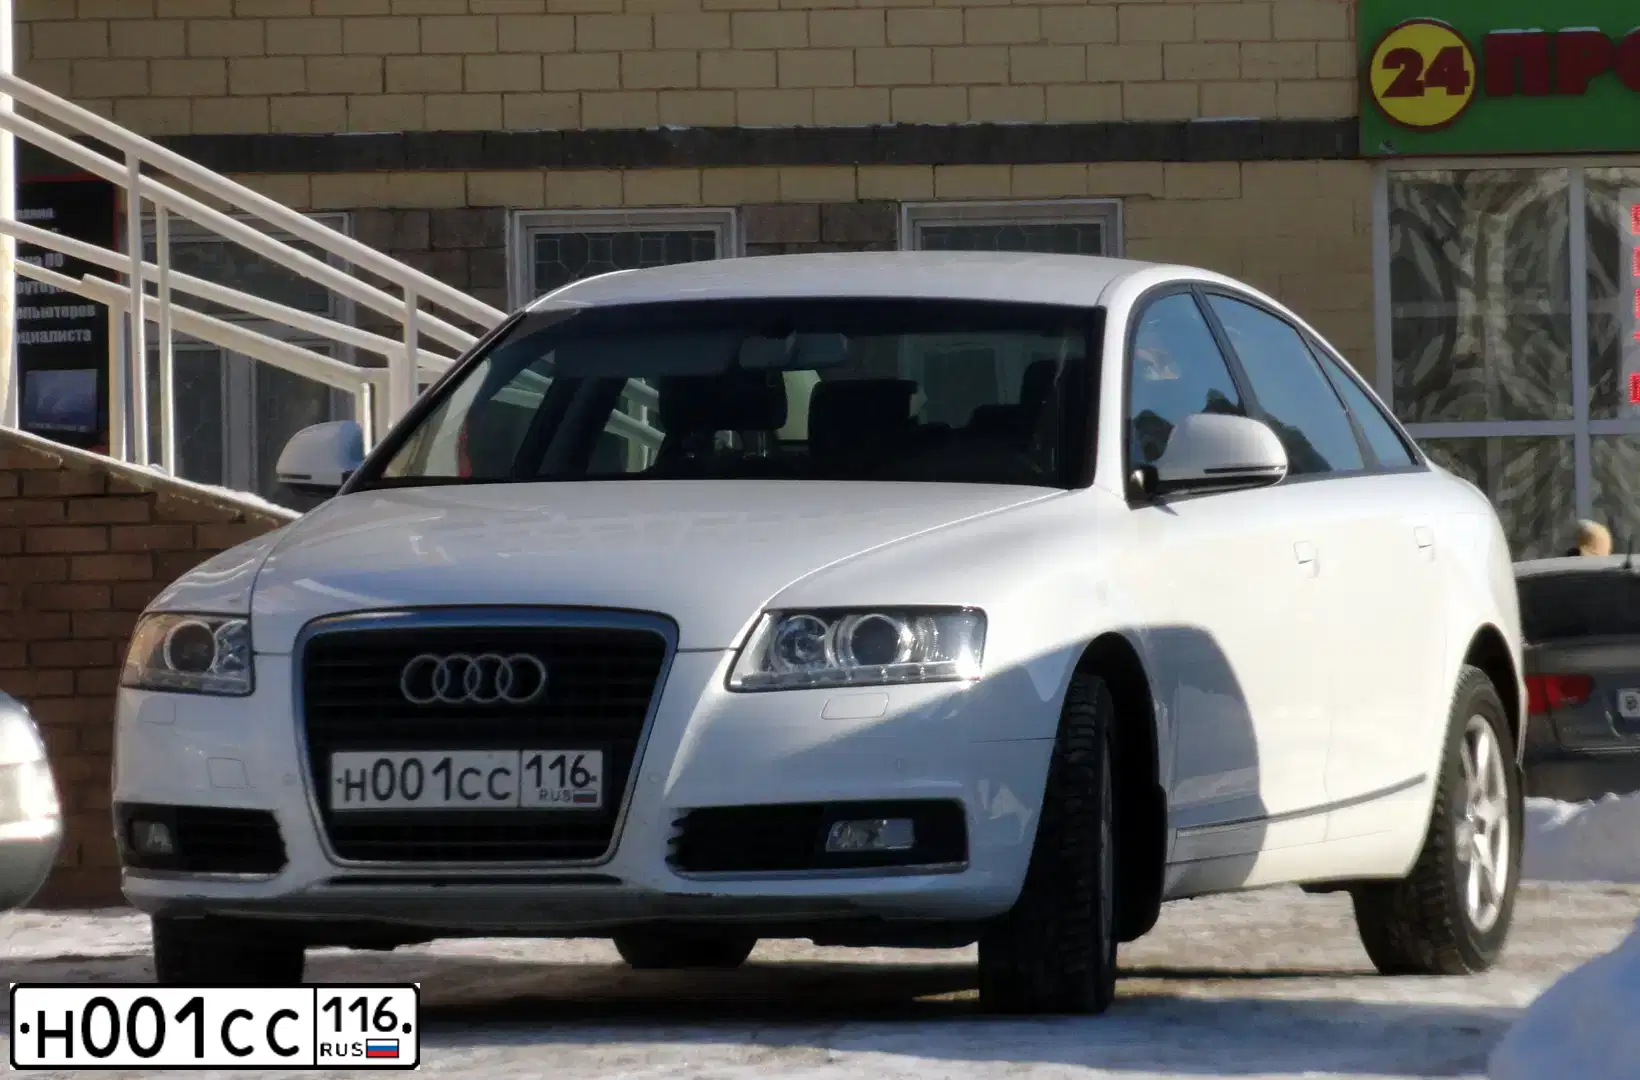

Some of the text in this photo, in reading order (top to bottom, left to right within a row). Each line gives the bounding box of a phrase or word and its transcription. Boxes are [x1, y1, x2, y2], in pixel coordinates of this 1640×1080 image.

[1380, 46, 1470, 98] 24
[344, 754, 590, 802] Н001СС 116
[538, 789, 572, 803] RUS
